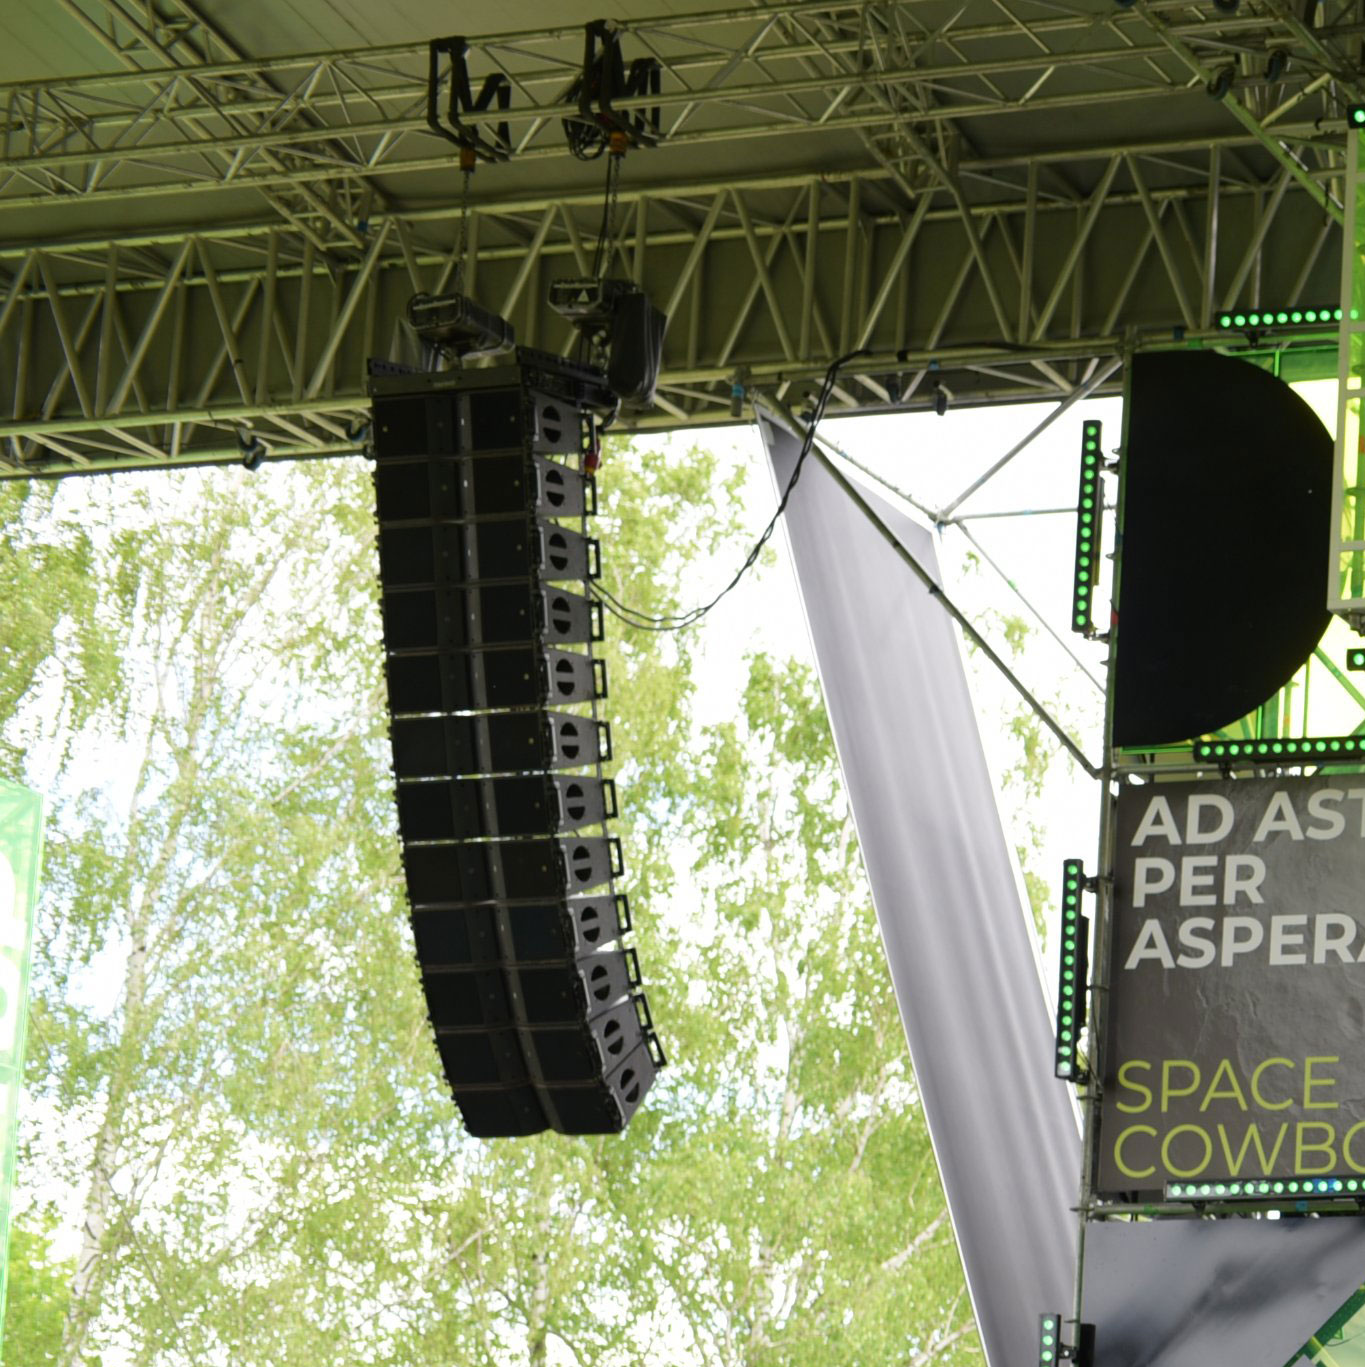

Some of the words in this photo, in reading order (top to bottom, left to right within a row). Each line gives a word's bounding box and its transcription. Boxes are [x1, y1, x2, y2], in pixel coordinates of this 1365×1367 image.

[1130, 794, 1235, 847] AD
[1131, 854, 1267, 908] PER
[1115, 1055, 1340, 1114] SPACE
